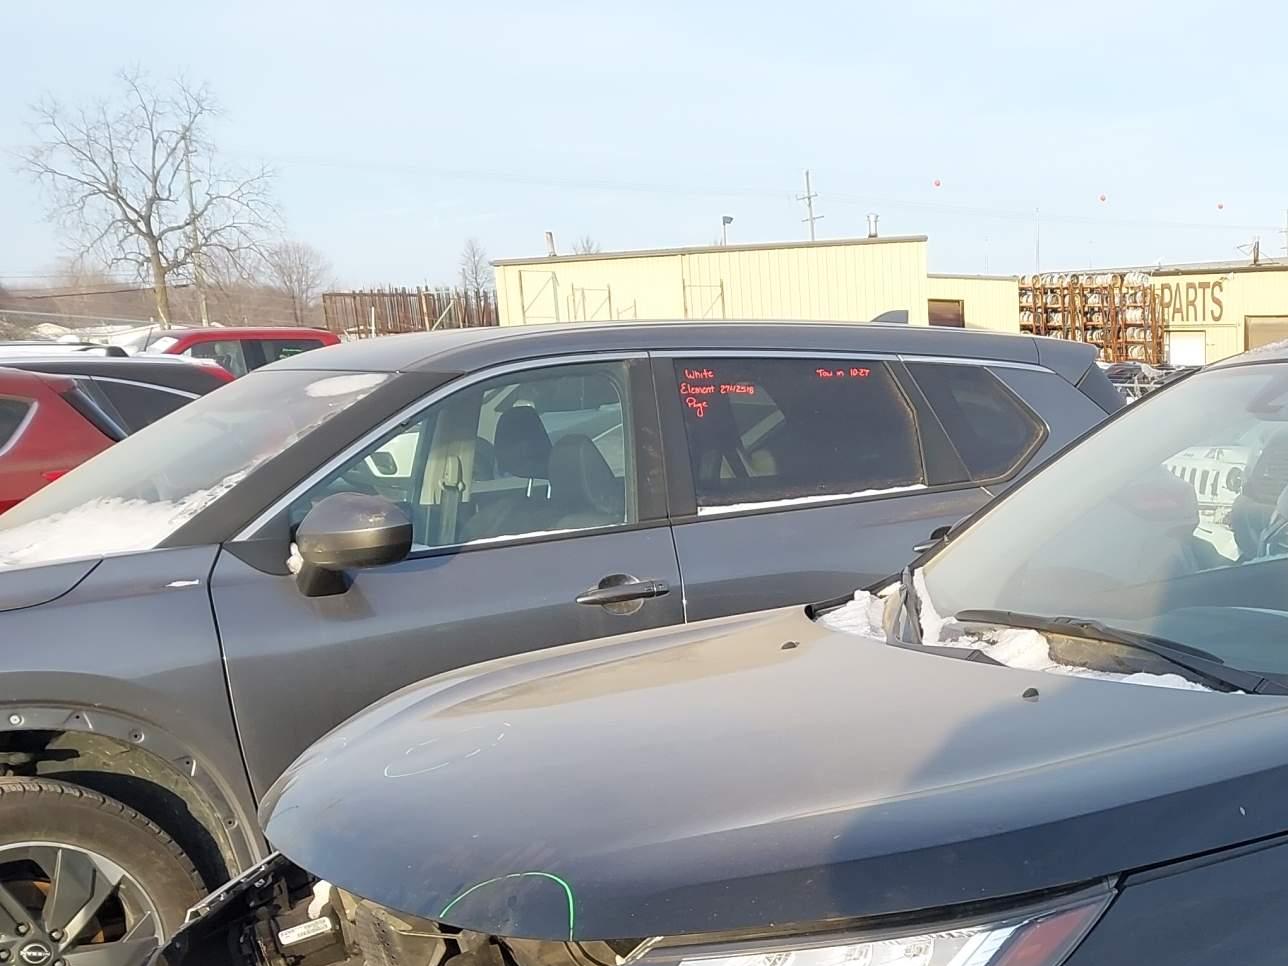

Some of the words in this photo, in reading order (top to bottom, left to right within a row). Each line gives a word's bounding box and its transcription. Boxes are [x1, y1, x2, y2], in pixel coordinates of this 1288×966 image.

[1160, 281, 1224, 323] PARTS
[684, 368, 714, 379] White
[680, 382, 715, 394] Element
